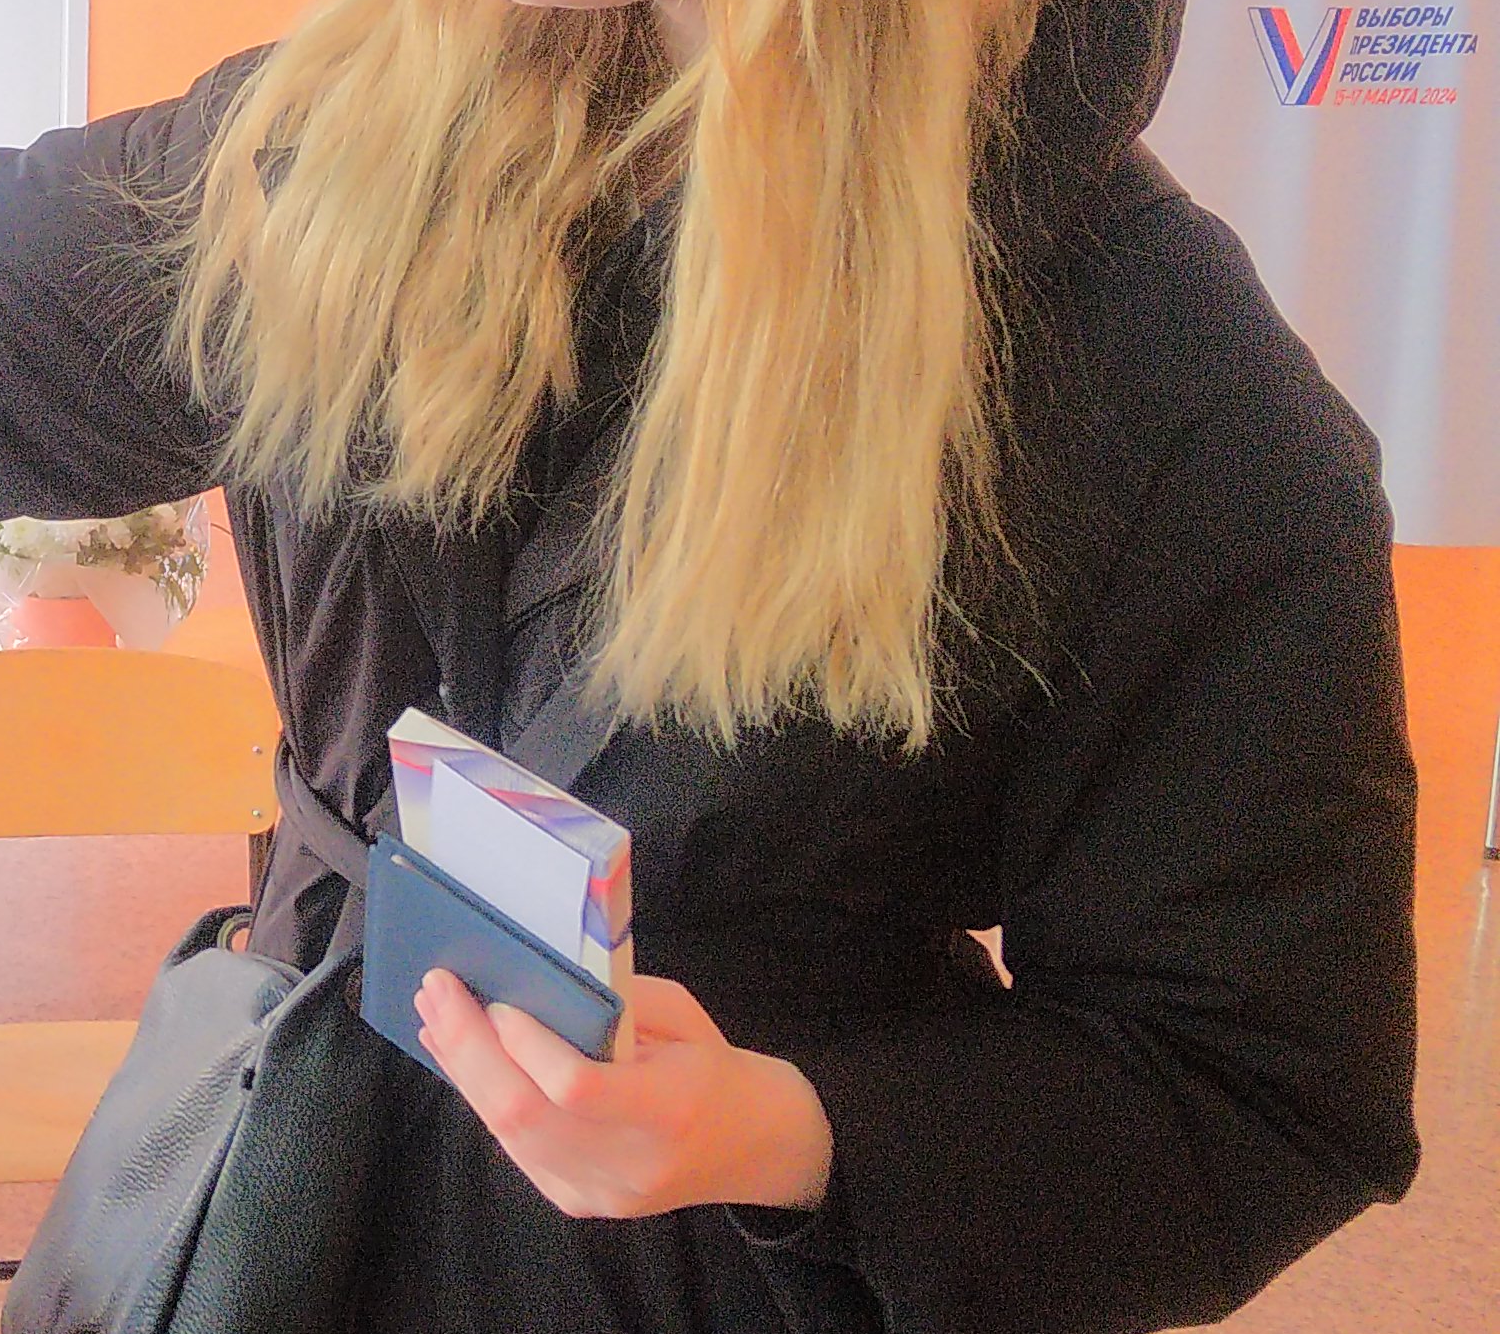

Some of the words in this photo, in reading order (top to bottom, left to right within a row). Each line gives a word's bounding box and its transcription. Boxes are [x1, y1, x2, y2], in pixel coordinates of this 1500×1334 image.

[1356, 6, 1454, 28] ВЫБОРЫ
[1349, 33, 1478, 57] ПРЕЗИДЕНТА
[1339, 62, 1421, 82] РОССИИ
[1362, 88, 1417, 105] МАРТА
[1419, 88, 1457, 105] 2024
